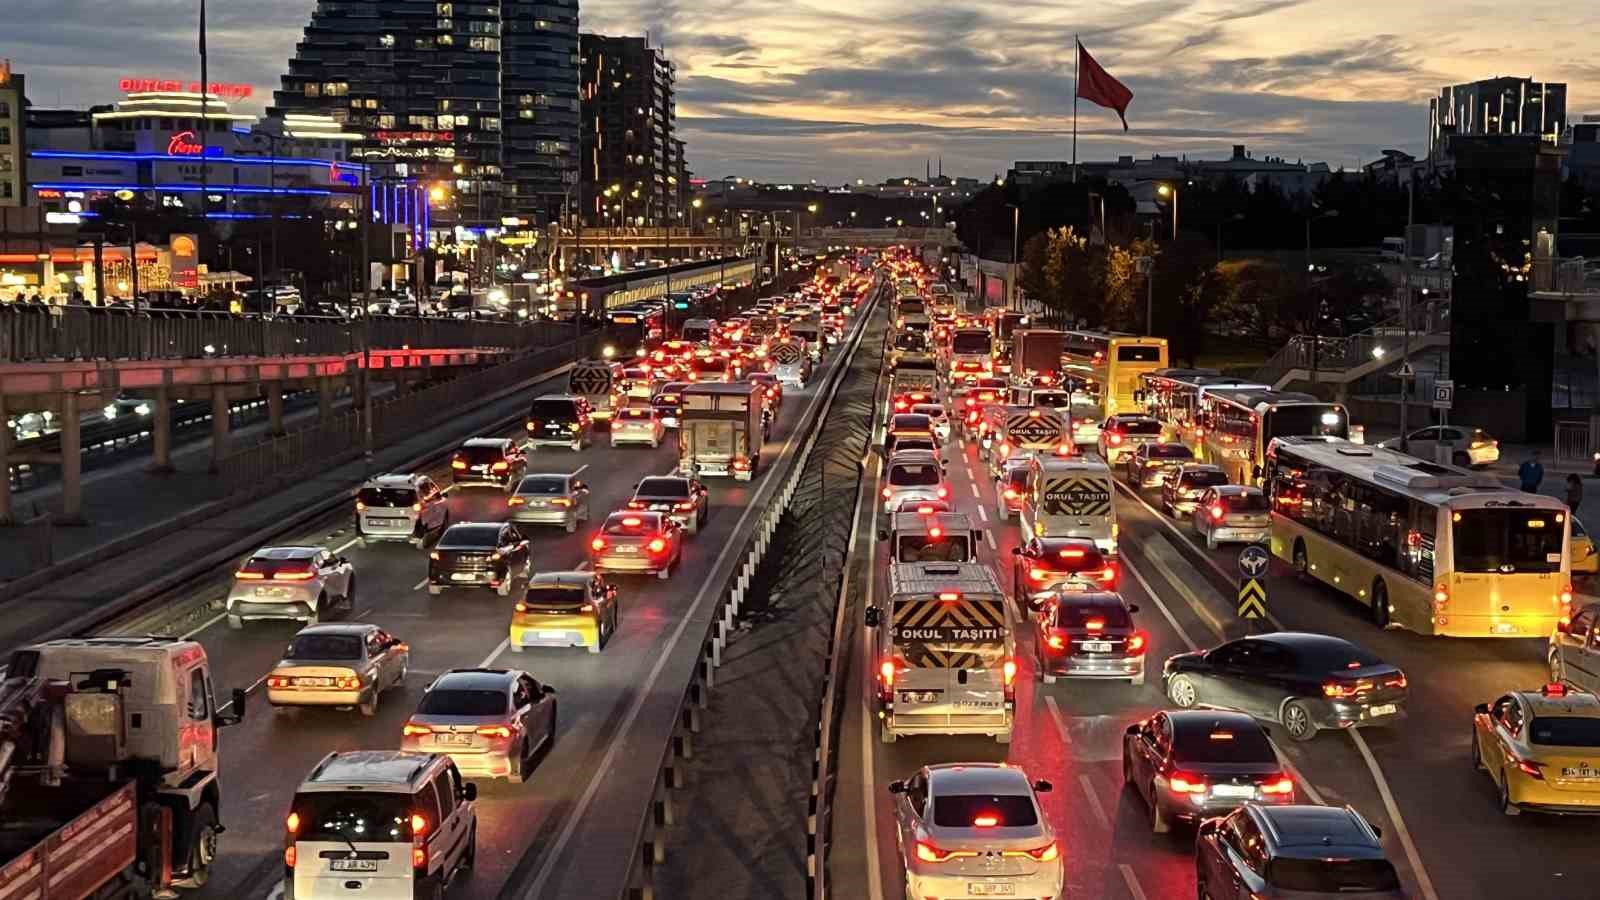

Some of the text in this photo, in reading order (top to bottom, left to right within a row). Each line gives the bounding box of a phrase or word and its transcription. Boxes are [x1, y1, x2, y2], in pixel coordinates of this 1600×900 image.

[1046, 493, 1073, 501] OKUL
[902, 629, 997, 640] OKUL TAŞITI
